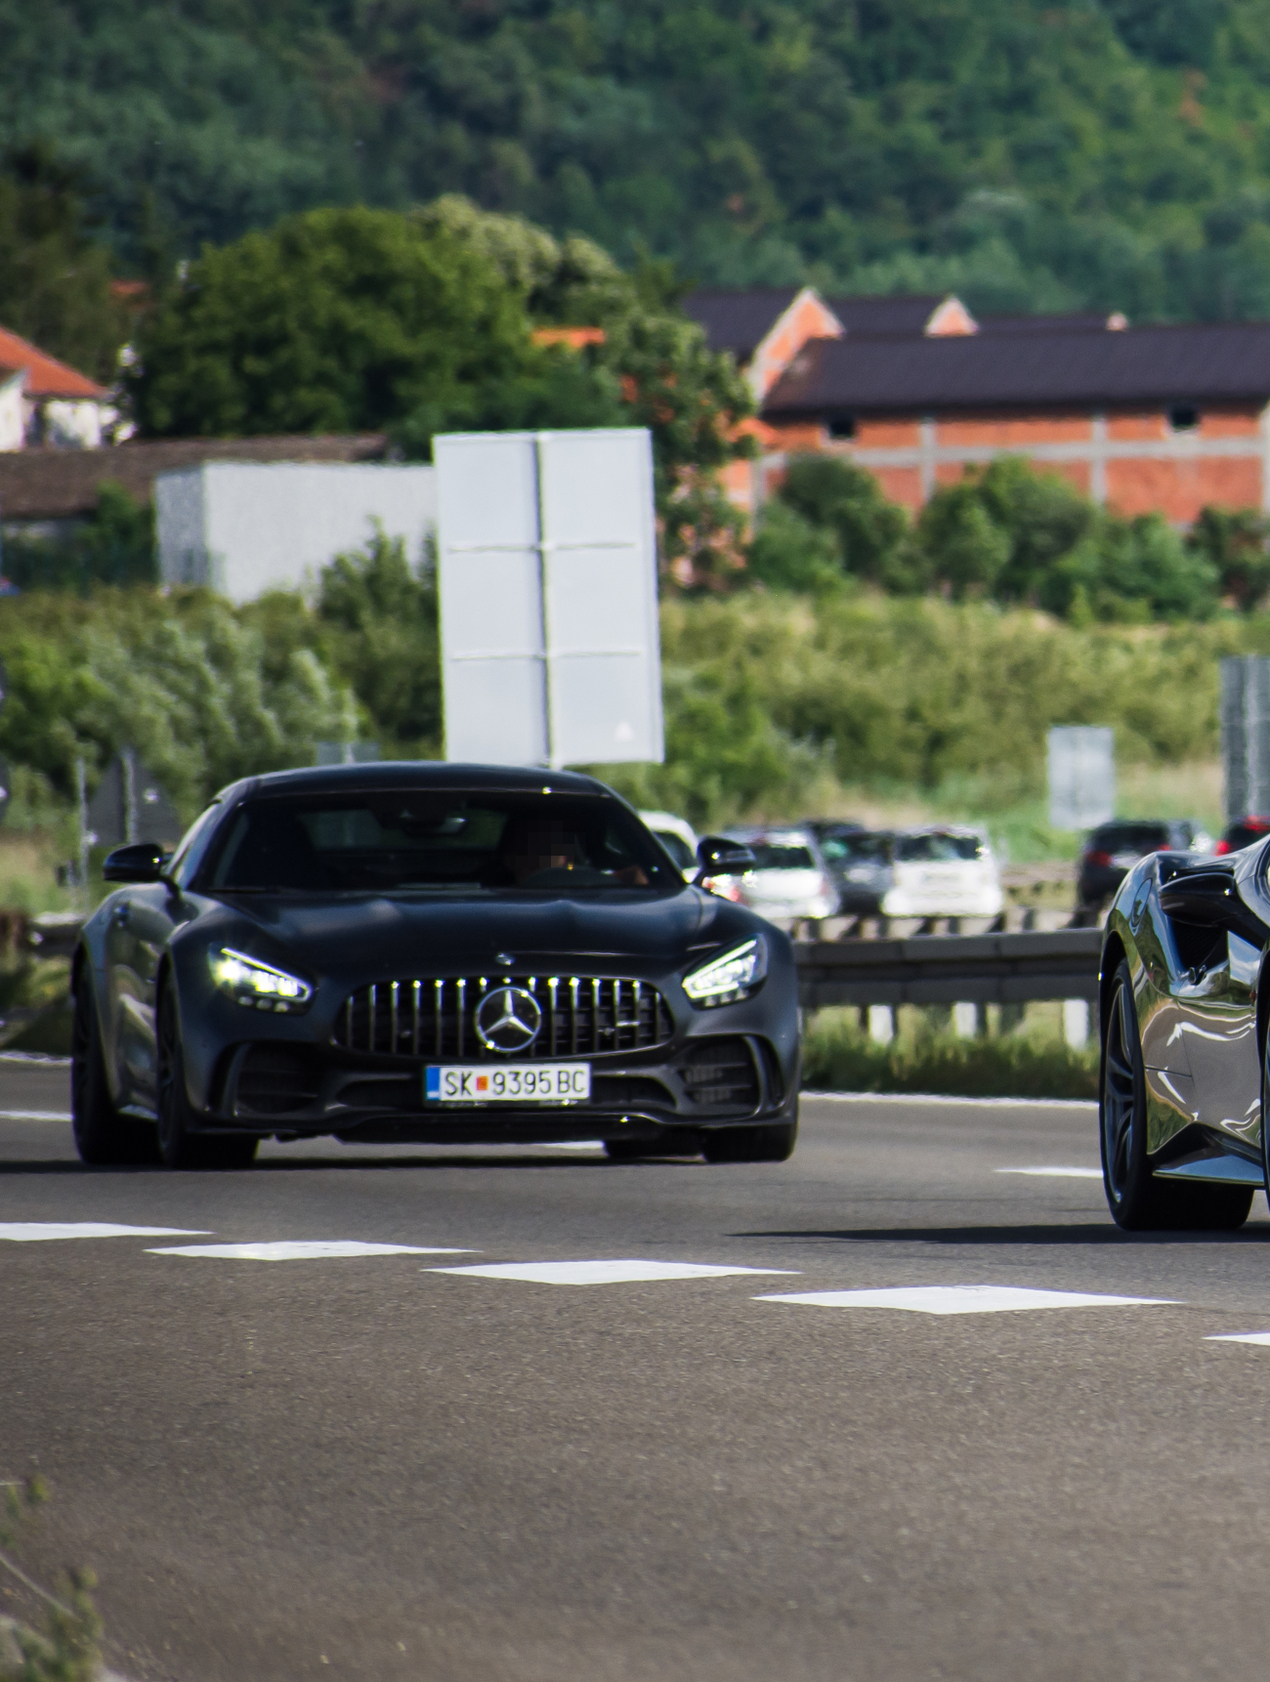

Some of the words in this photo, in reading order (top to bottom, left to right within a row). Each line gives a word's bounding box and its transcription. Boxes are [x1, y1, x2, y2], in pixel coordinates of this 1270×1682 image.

[445, 1071, 473, 1096] SK
[492, 1070, 552, 1095] 9395
[557, 1069, 585, 1094] BC
